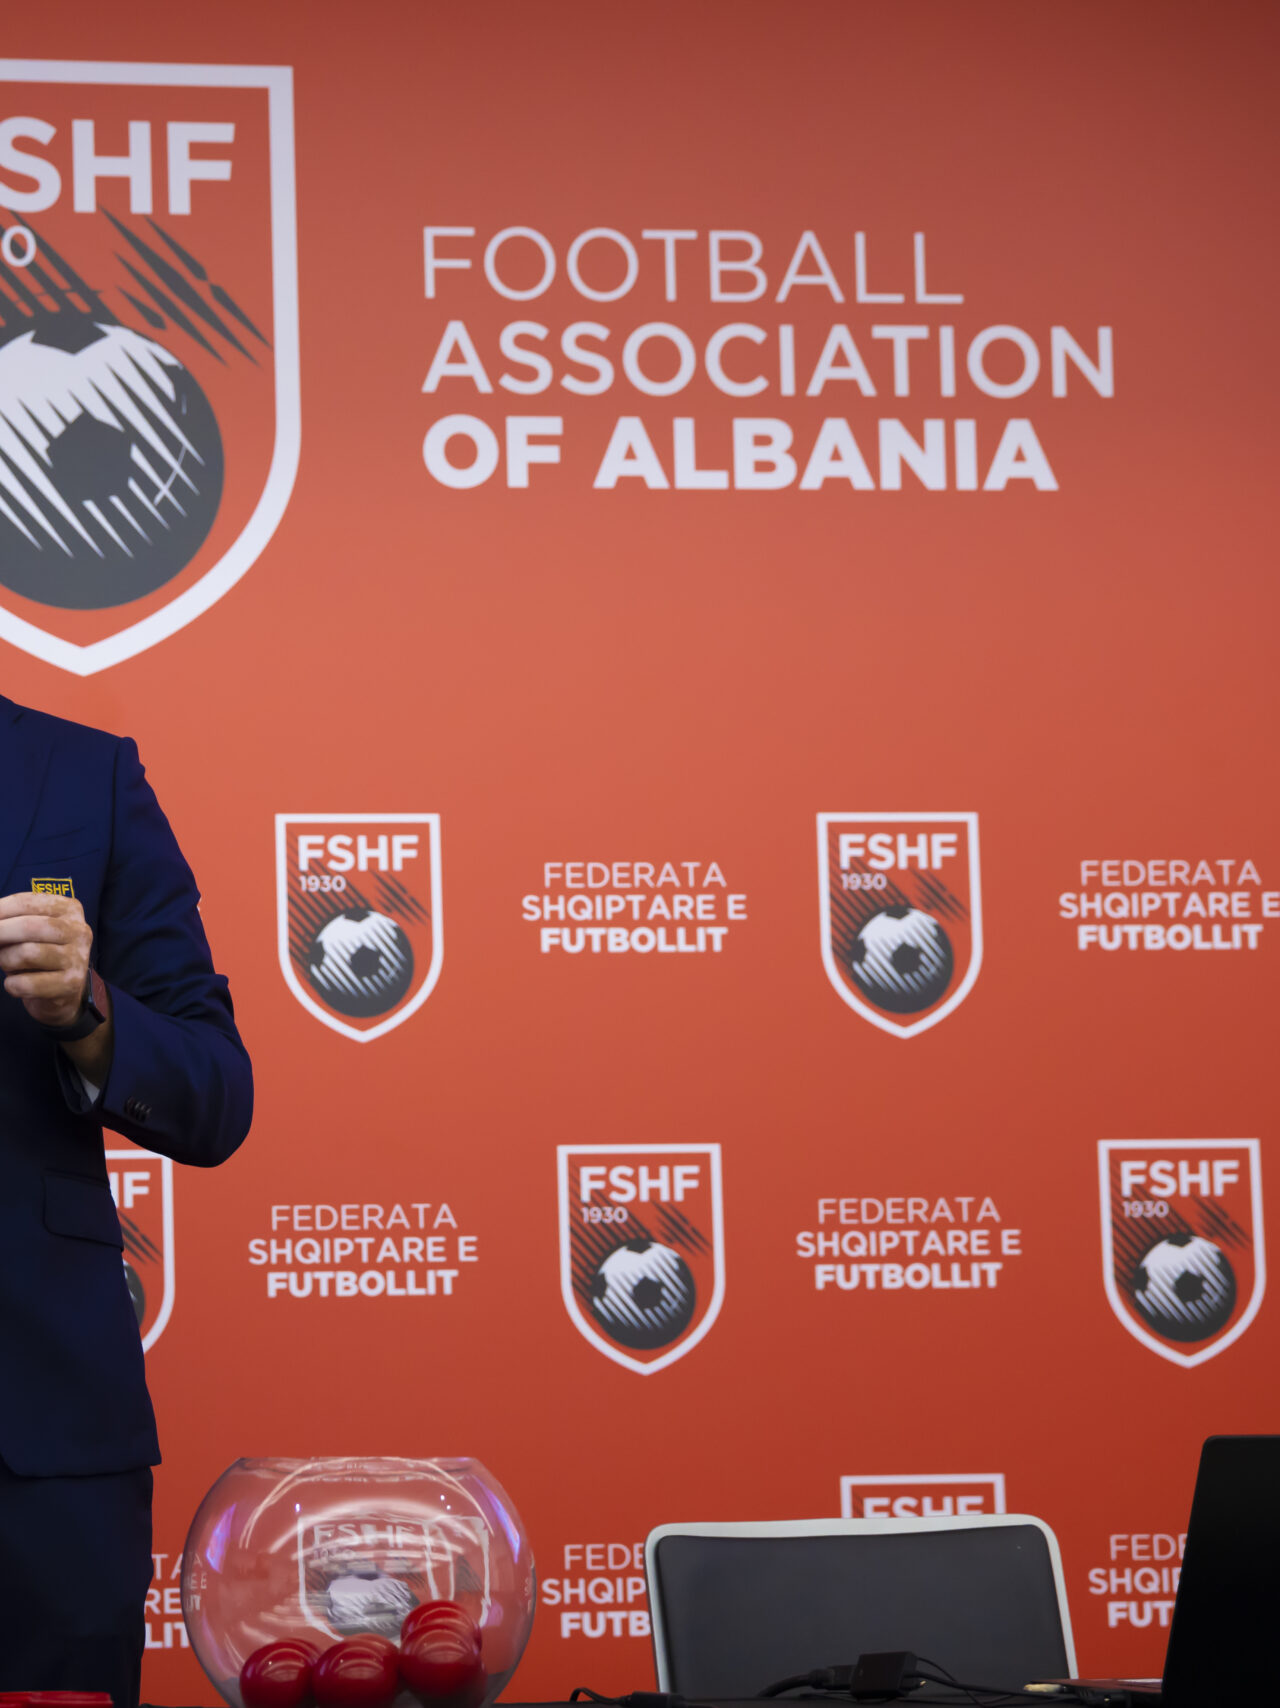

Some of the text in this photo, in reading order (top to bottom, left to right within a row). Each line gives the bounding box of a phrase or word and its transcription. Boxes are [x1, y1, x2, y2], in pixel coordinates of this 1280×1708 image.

[423, 225, 965, 305] FOOTBALL
[421, 319, 1115, 399] ASSOCIATION
[422, 413, 1059, 492] OF ALBANIA
[297, 834, 419, 873] FSHF
[838, 832, 958, 871] FSHF
[298, 874, 347, 893] 1930
[543, 861, 727, 889] FEDERATA
[840, 872, 888, 891] 1930
[1080, 859, 1262, 887] FEDERATA
[36, 883, 69, 895] FSHF
[521, 893, 748, 922] SHQIPTARE E
[1058, 891, 1280, 919] SHQIPTARE E
[540, 926, 729, 954] FUTBOLLIT
[1077, 923, 1264, 951] FUTBOLLIT
[579, 1164, 701, 1204] FSHF
[1120, 1159, 1240, 1198] FSHF
[271, 1202, 458, 1232] FEDERATA
[580, 1206, 629, 1224] 1930
[817, 1196, 1001, 1225] FEDERATA
[1121, 1199, 1170, 1219] 1930
[248, 1235, 479, 1266] SHQIPTARE E
[795, 1228, 1022, 1259] SHQIPTARE E
[266, 1268, 459, 1299] FUTBOLLIT
[814, 1261, 1003, 1291] FUTBOLLIT
[541, 1576, 646, 1605] SHQIP
